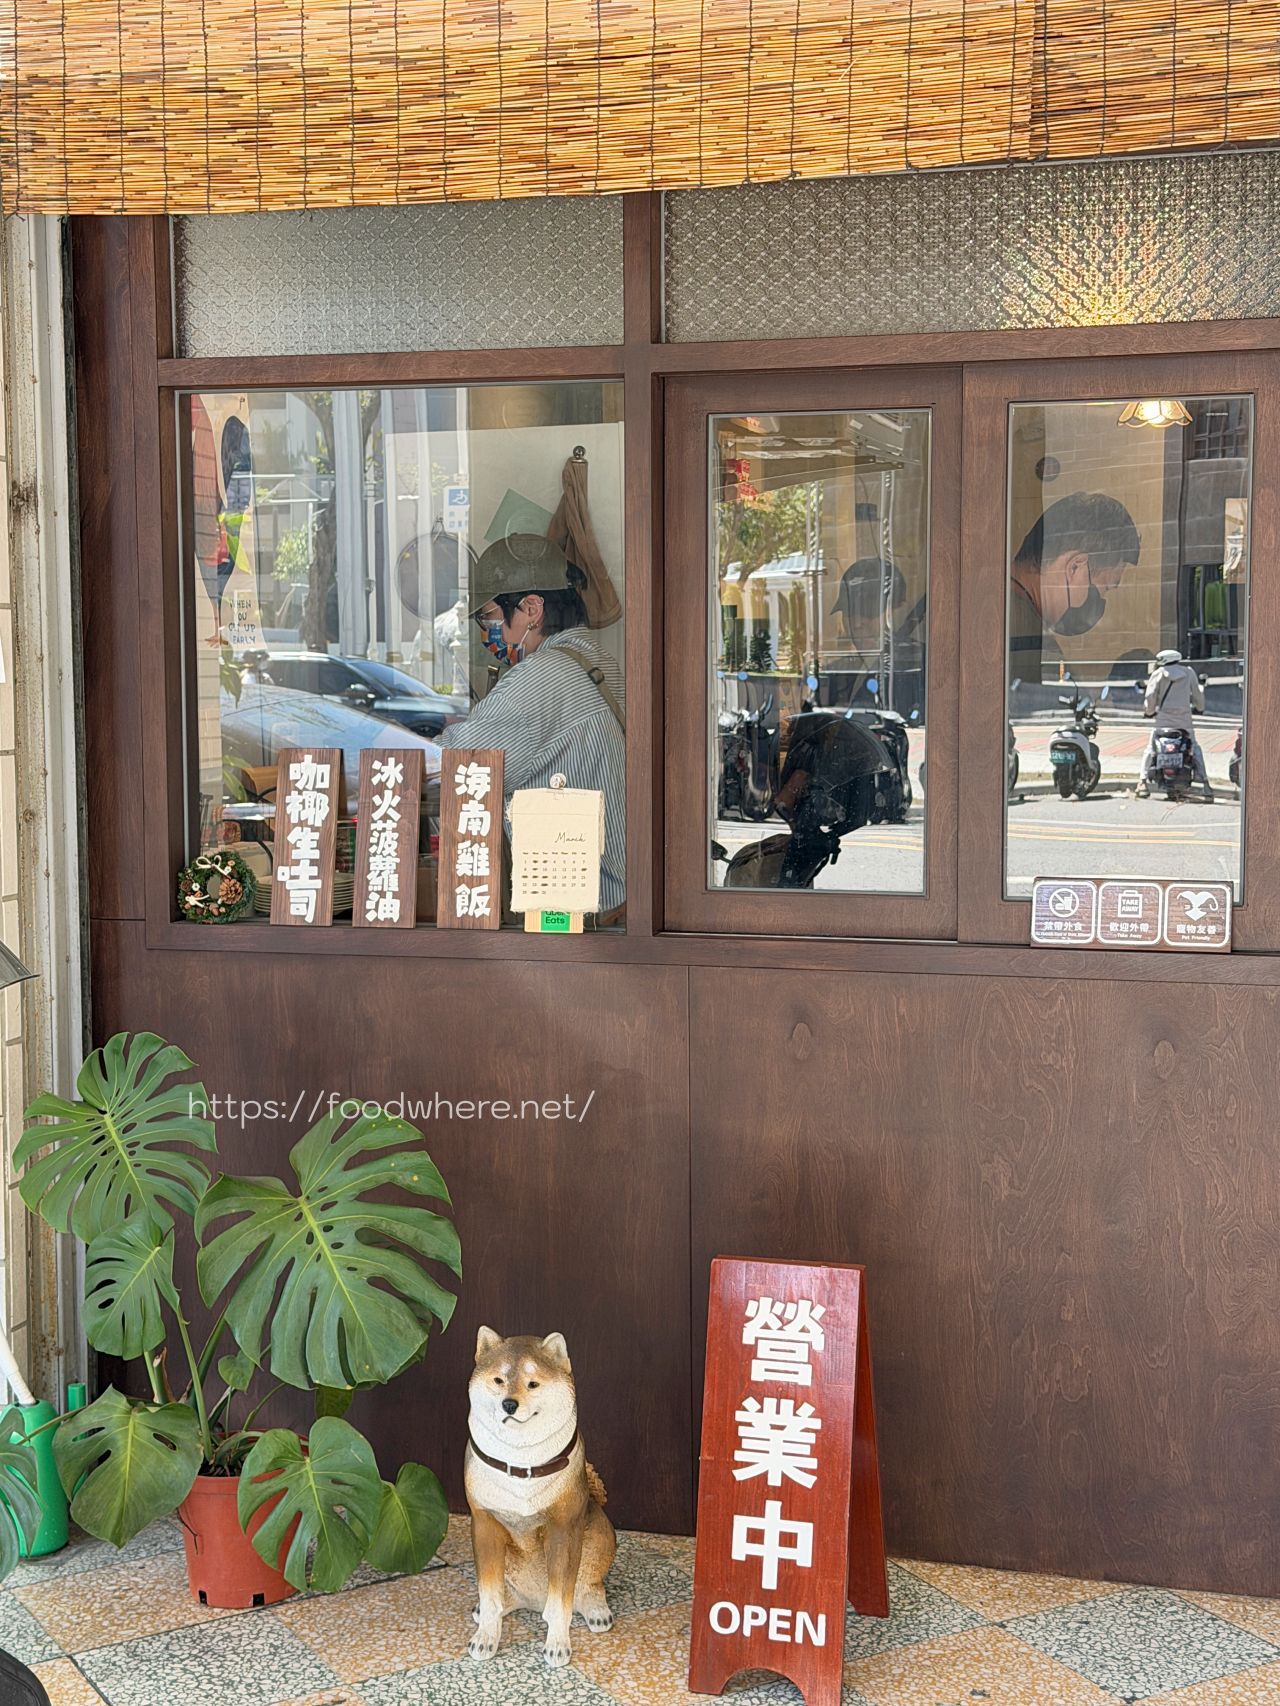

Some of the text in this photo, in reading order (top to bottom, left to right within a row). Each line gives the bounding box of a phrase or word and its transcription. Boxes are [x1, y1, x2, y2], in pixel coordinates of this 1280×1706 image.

[277, 754, 331, 924] 咖椰生吐司
[365, 756, 405, 923] 冰火菠蘿油
[454, 761, 492, 919] 海南雞飯
[546, 916, 565, 924] Eats
[730, 1296, 828, 1591] 營業中
[708, 1600, 827, 1648] OPEN
